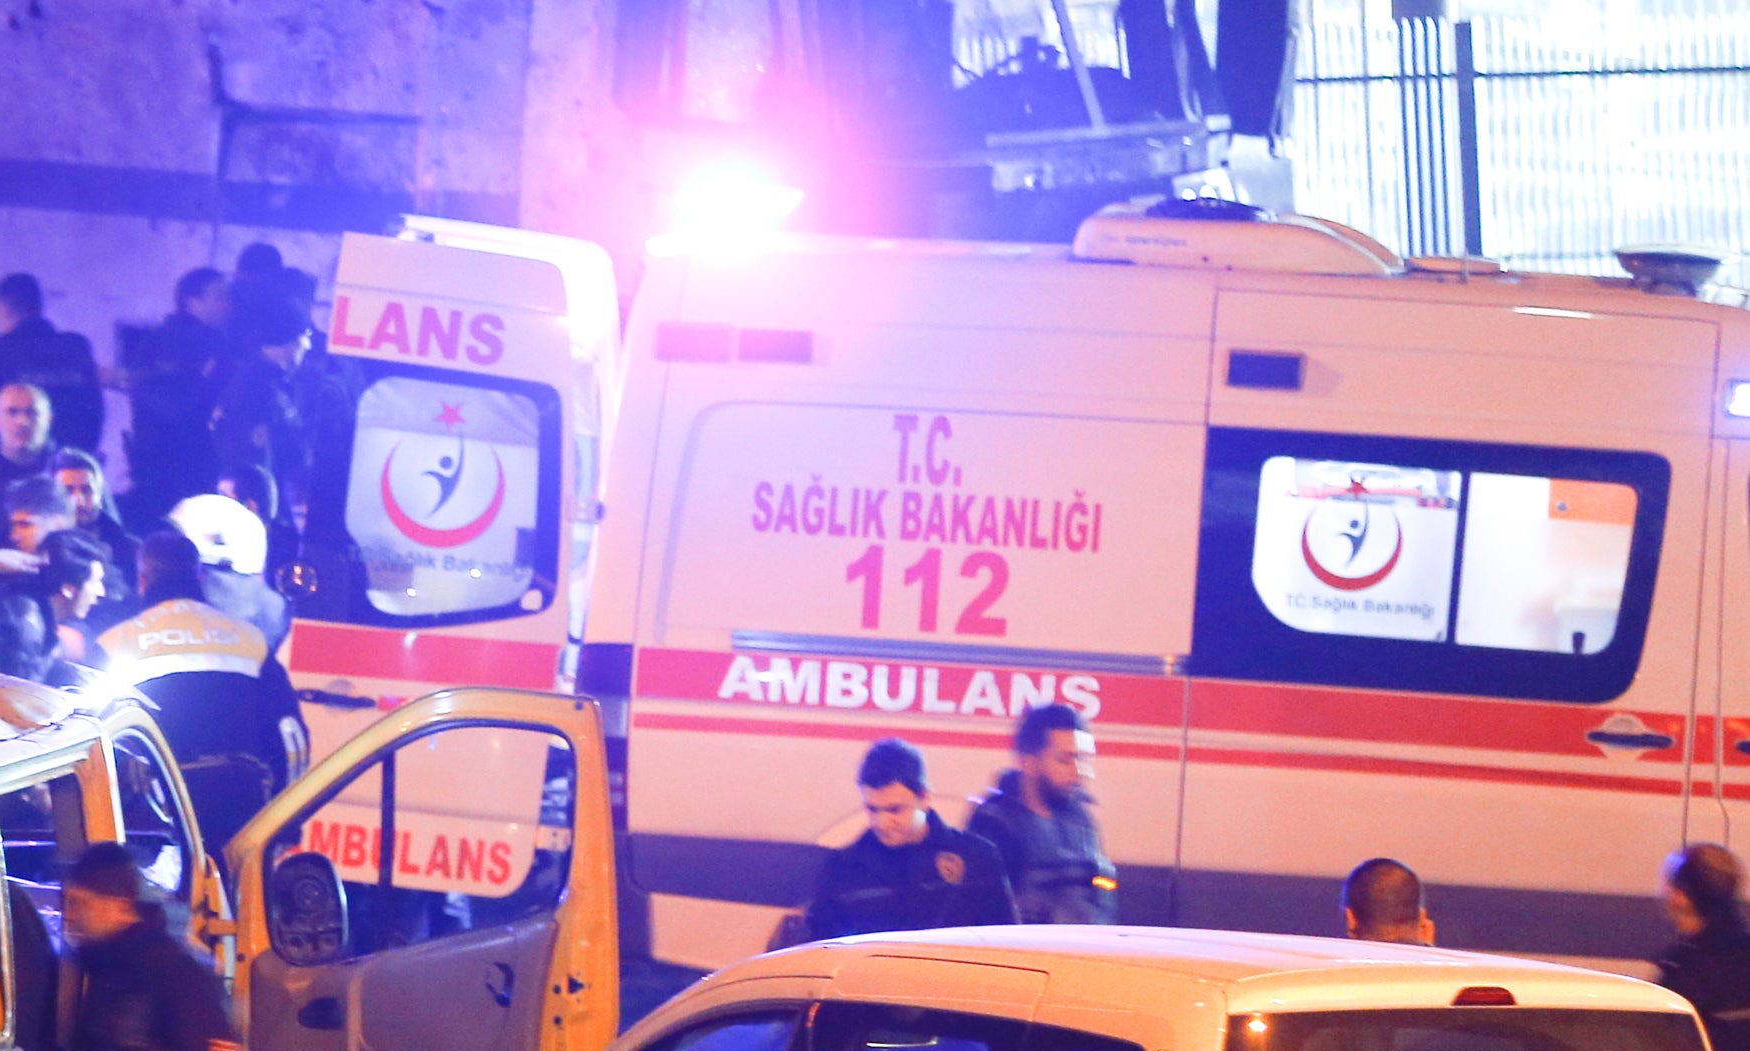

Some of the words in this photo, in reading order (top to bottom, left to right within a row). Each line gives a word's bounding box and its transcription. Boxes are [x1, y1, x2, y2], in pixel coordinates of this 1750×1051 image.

[331, 296, 505, 365] LANS
[893, 414, 962, 486] T.C.
[752, 473, 888, 539] SAĞLIK
[900, 489, 1103, 553] BAKANLIĞI
[845, 544, 1010, 637] 112
[717, 655, 1101, 720] AMBULANS
